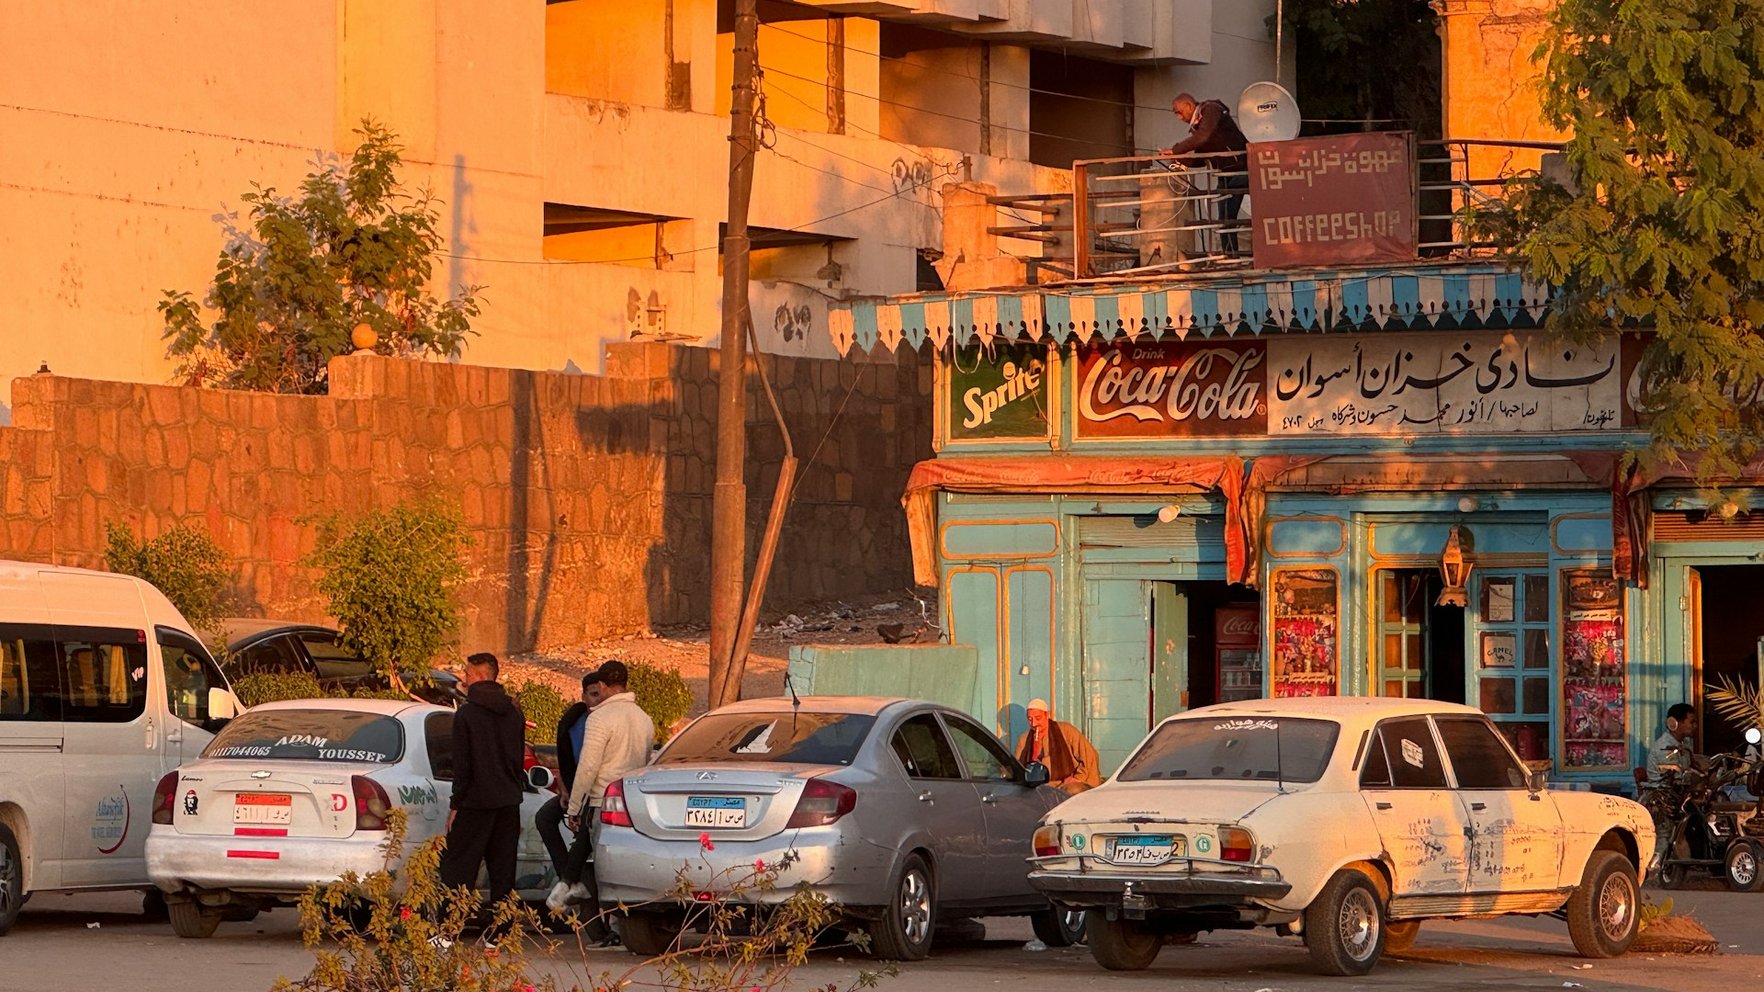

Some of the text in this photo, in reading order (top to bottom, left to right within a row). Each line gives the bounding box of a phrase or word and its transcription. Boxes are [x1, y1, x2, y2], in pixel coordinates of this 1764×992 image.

[1132, 348, 1165, 360] Drink
[1276, 341, 1363, 401] أسوان
[1361, 342, 1475, 400] خزان
[963, 359, 1044, 429] Sprite
[1080, 348, 1265, 422] Coca-Cola
[1487, 647, 1513, 657] CAMEL
[275, 735, 327, 748] ADAM
[318, 749, 386, 763] YOUSSEF
